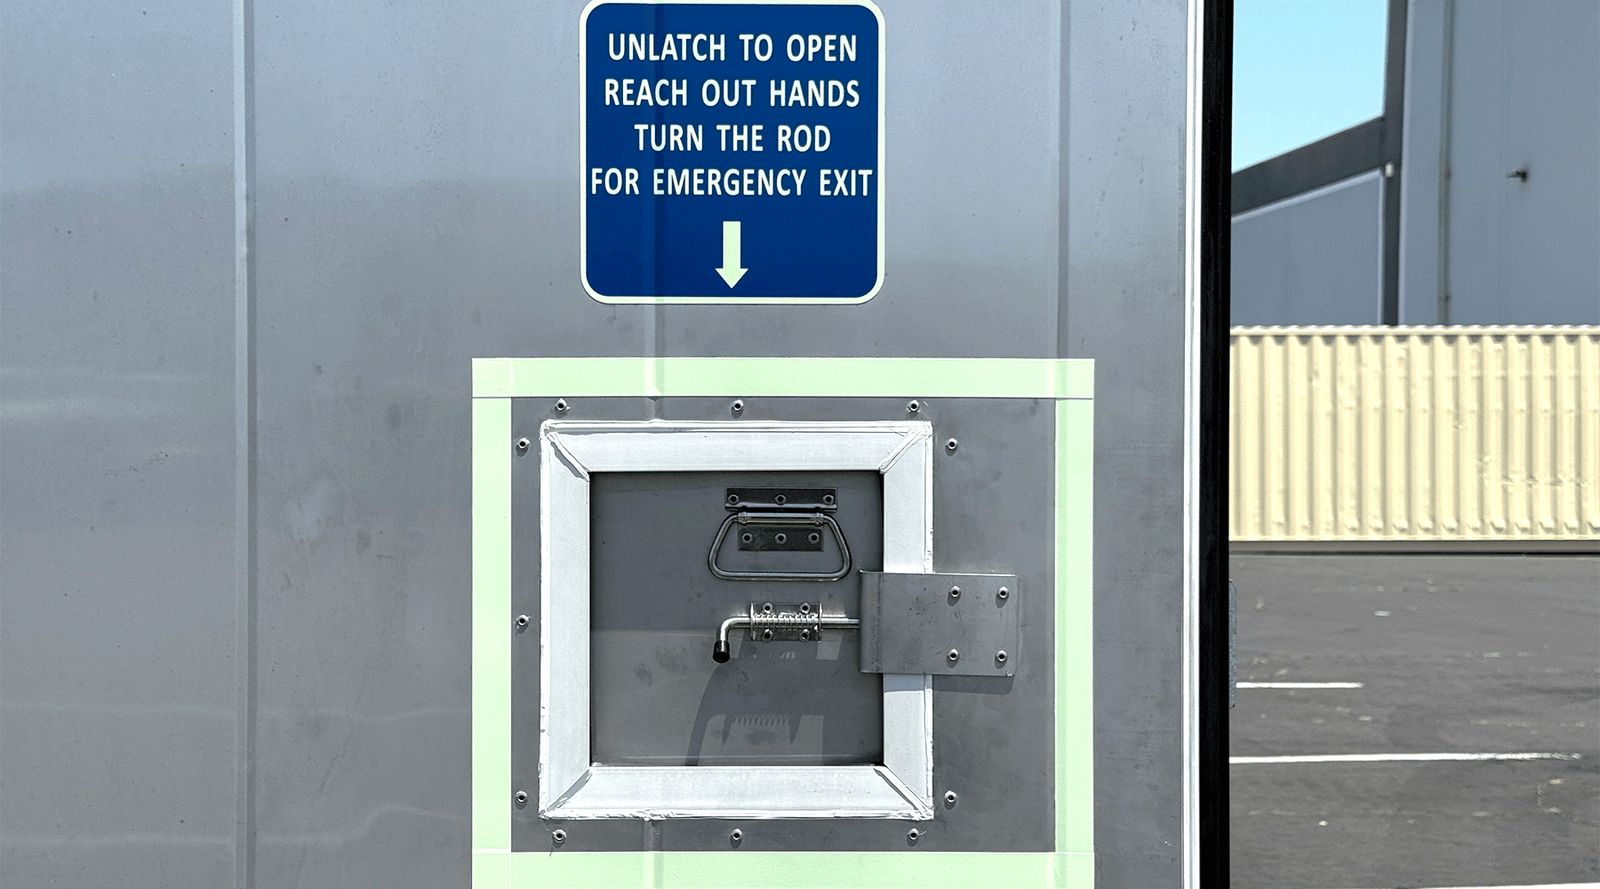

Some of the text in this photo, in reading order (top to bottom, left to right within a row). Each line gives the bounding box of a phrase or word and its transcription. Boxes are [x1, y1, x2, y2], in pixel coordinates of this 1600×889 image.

[608, 33, 857, 62] UNLATCH TO OPEN
[604, 78, 860, 108] REACH OUT HANDS
[633, 124, 831, 152] TURN THE ROD
[591, 167, 873, 197] FOR EMERGENCY EXIT
